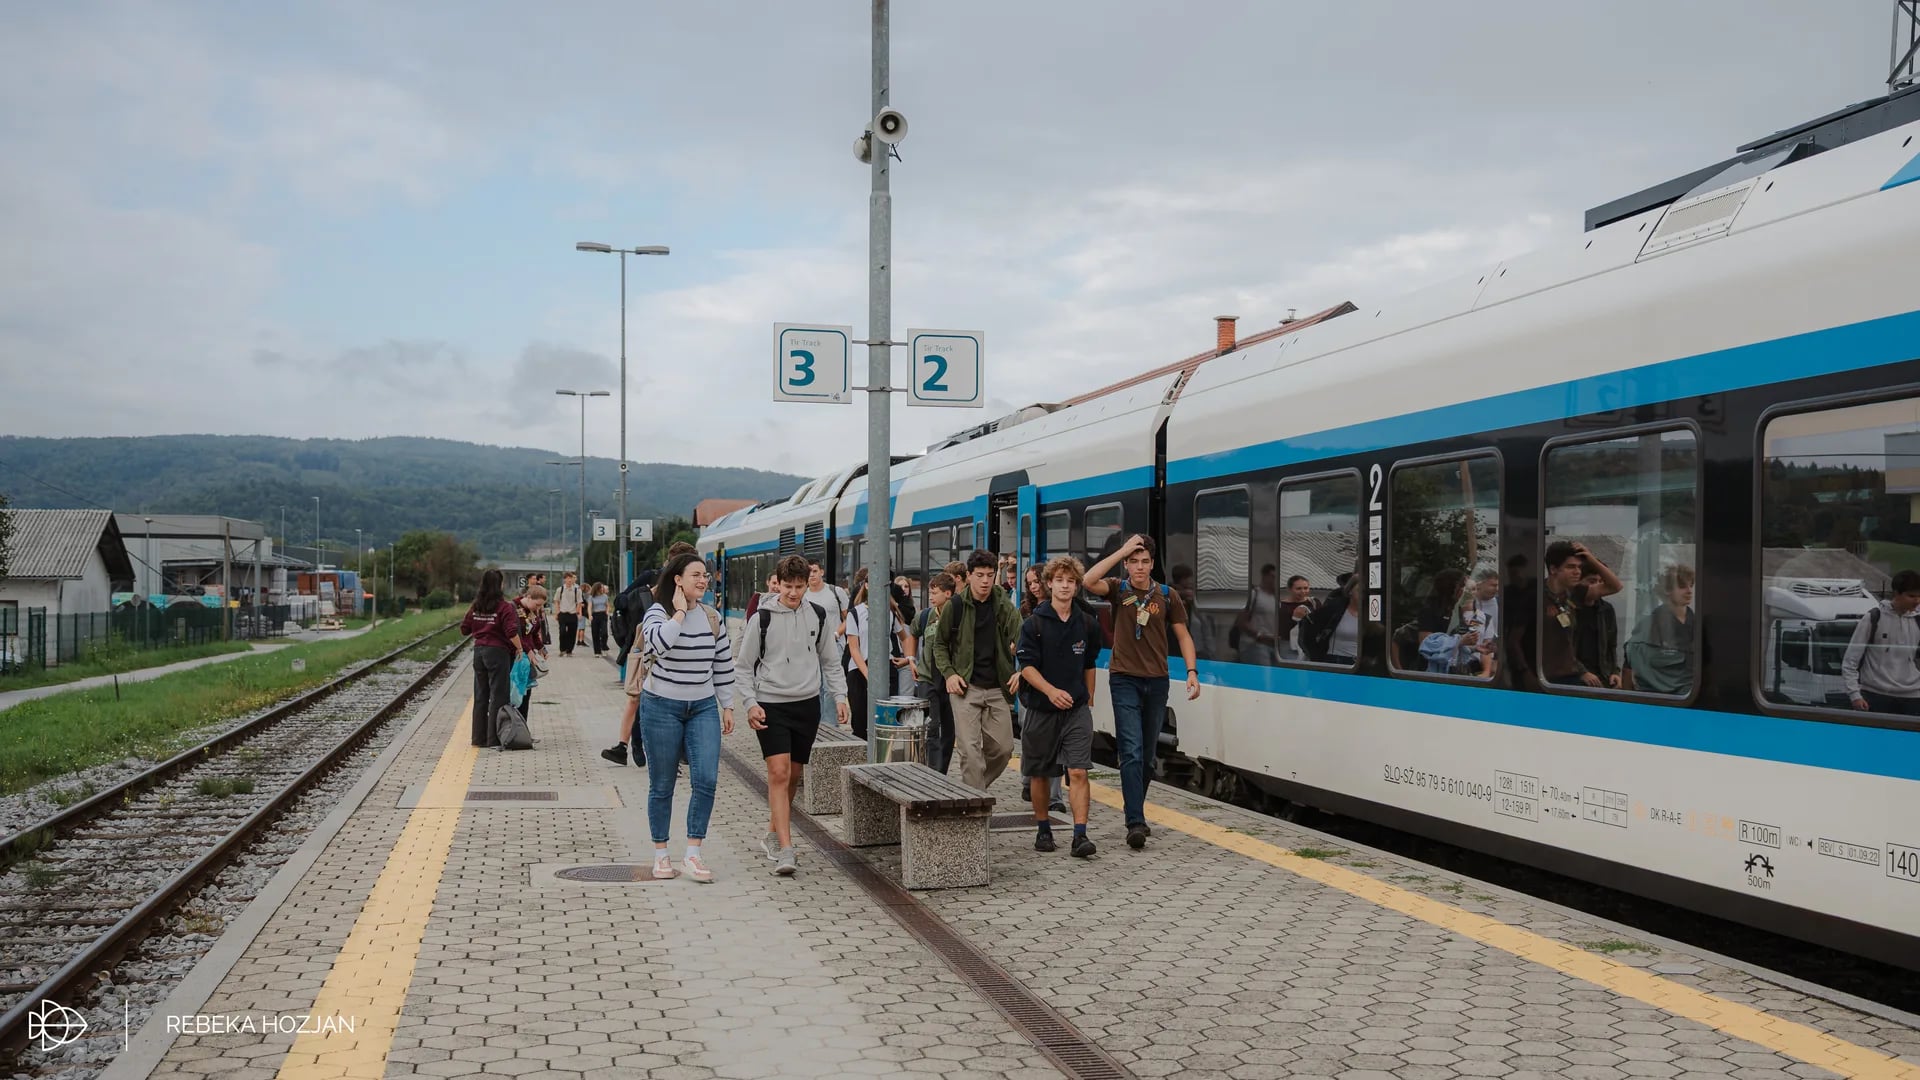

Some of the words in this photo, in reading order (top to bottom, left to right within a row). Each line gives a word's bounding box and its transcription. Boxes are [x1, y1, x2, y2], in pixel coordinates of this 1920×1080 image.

[788, 349, 815, 387] 3
[923, 354, 949, 392] 2
[1369, 463, 1383, 511] 2
[597, 525, 606, 537] 3
[634, 526, 642, 537] 2
[951, 525, 957, 550] 2
[519, 577, 526, 587] S
[1416, 771, 1427, 788] 95
[1428, 774, 1439, 790] 79
[1440, 776, 1446, 792] 5
[1448, 778, 1464, 796] 610
[1466, 782, 1492, 802] 040-9
[1520, 780, 1535, 795] 151t
[1502, 798, 1524, 814] 12-159
[1650, 807, 1660, 821] DK
[1661, 809, 1682, 825] R-A-E
[1741, 823, 1748, 840] R
[1751, 826, 1778, 845] 100m
[1838, 845, 1843, 856] S
[1888, 849, 1919, 878] 140
[1748, 874, 1771, 890] 500m
